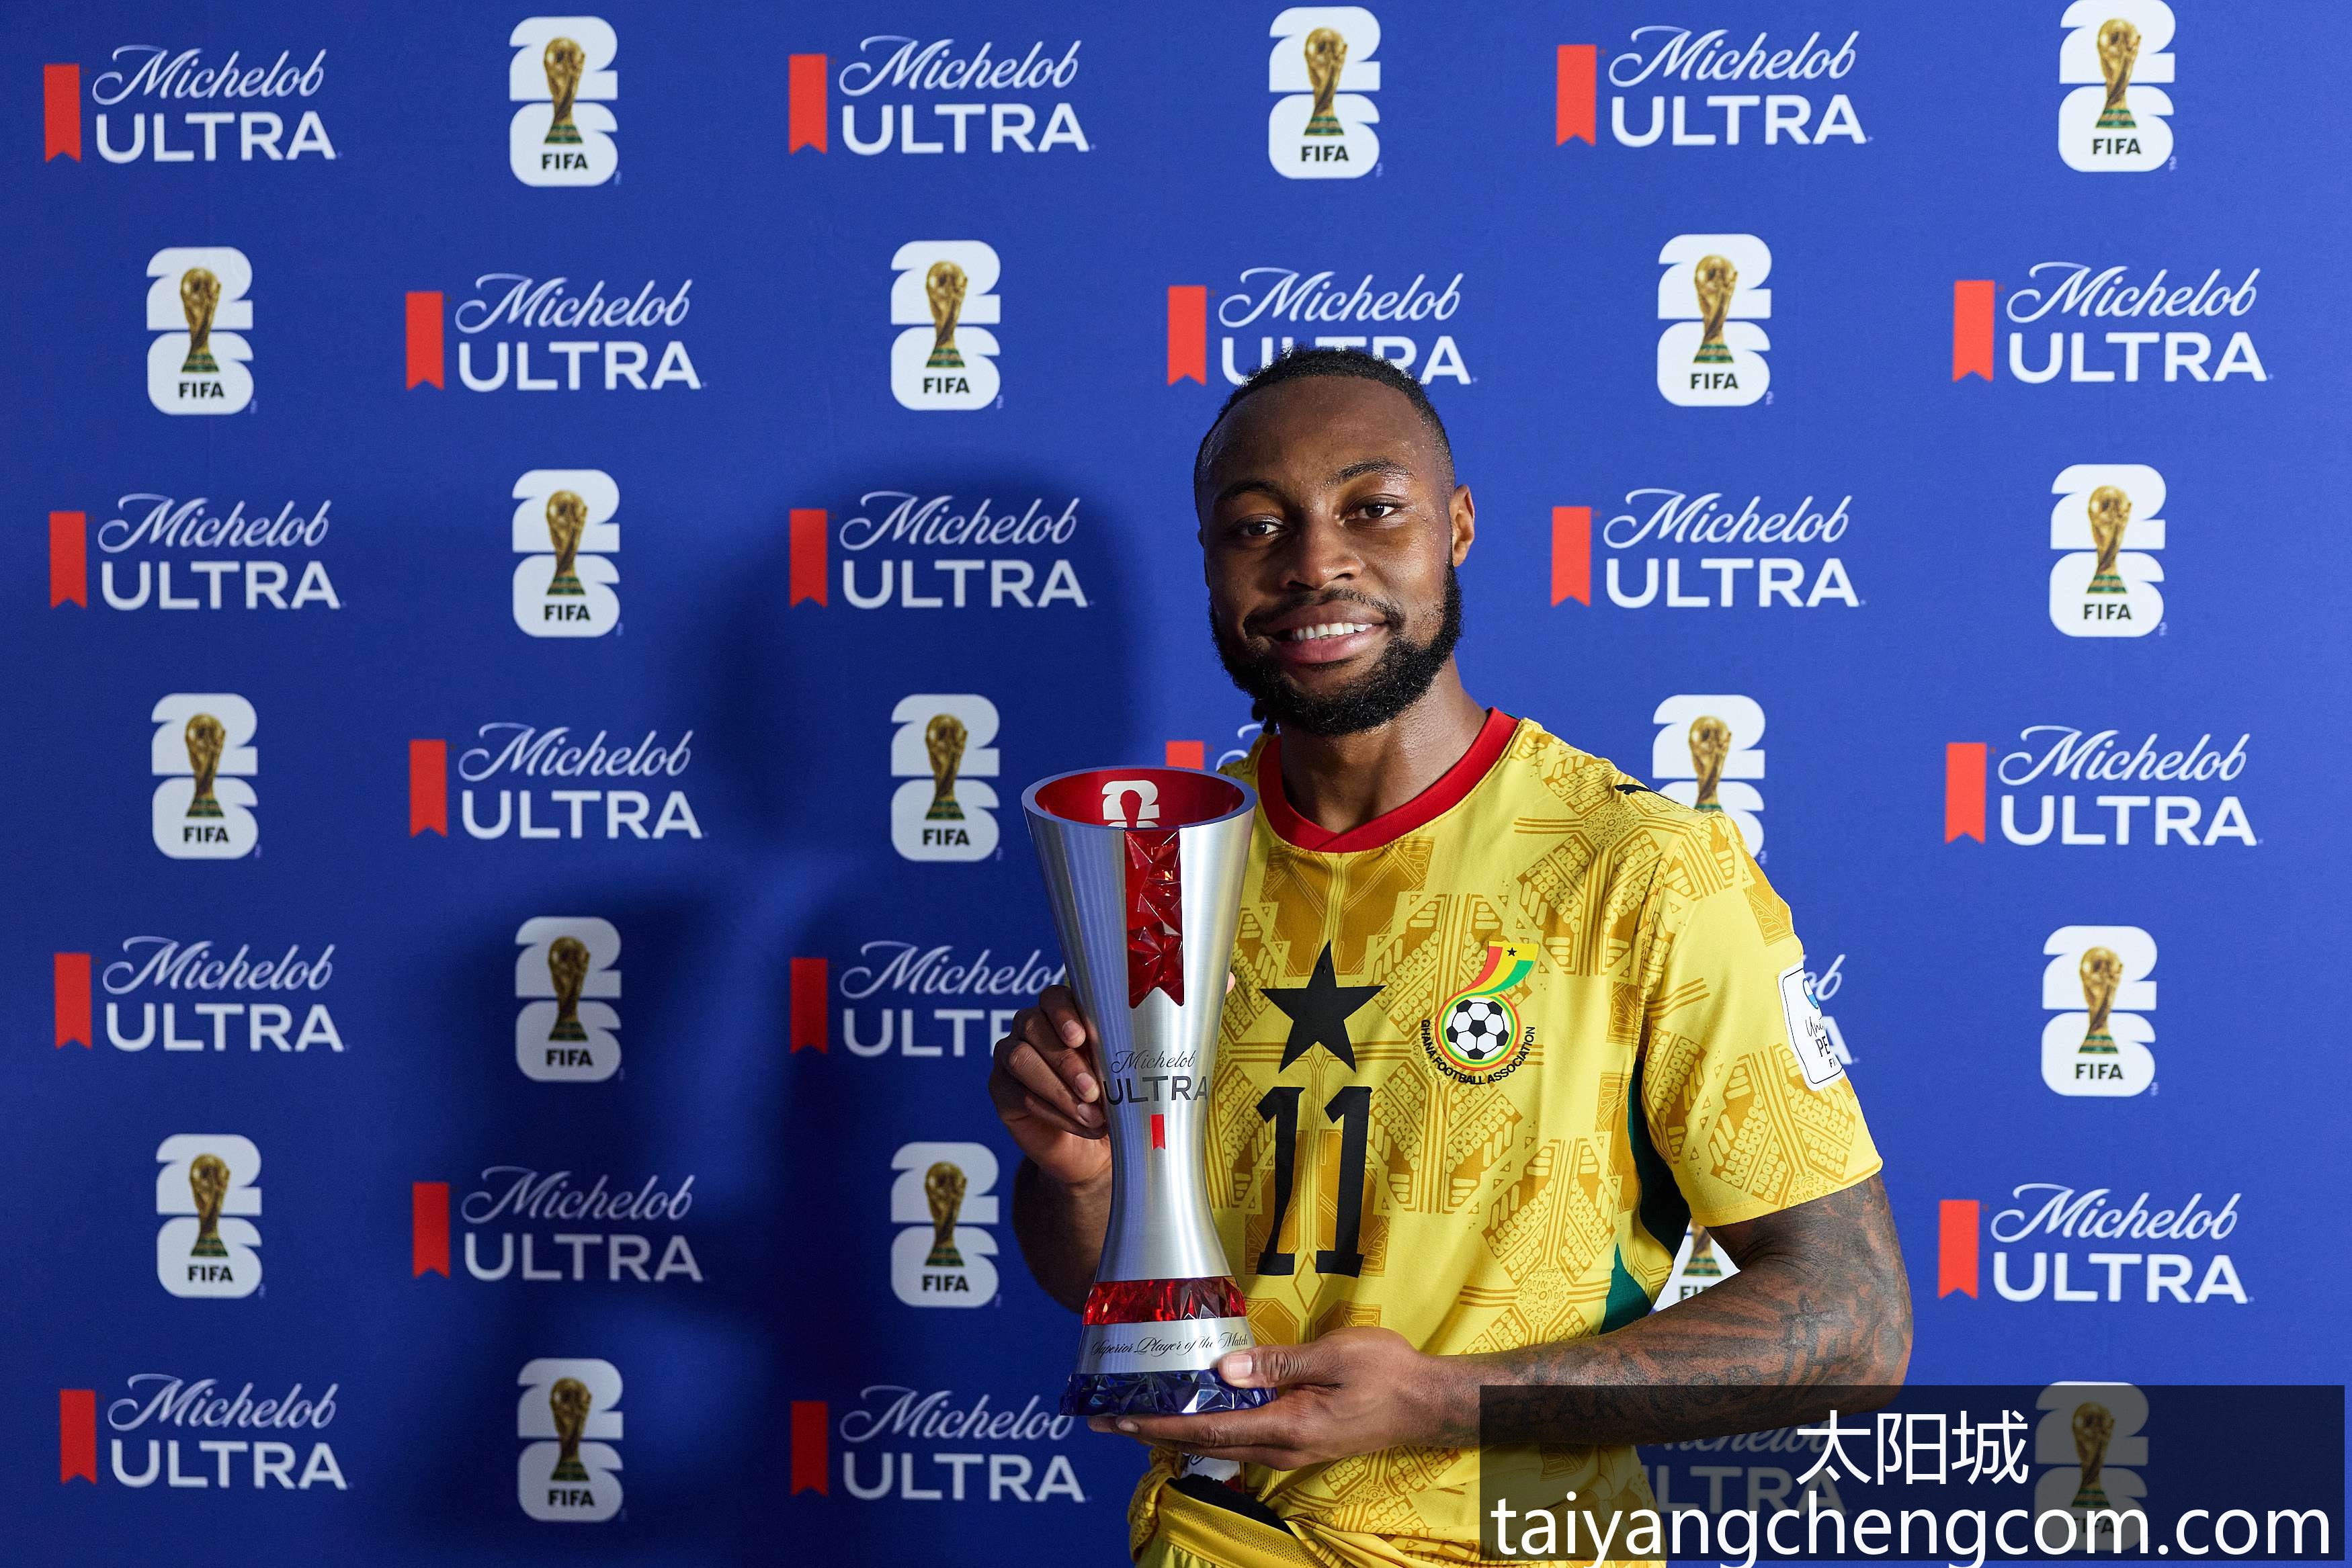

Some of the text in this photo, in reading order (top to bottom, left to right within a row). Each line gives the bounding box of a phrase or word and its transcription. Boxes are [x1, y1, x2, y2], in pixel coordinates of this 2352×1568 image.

[93, 46, 326, 105] Michelob
[839, 36, 1081, 96] Michelob
[1609, 26, 1859, 87] Michelob
[96, 111, 336, 163] ULTRA
[843, 103, 1089, 155] ULTRA
[1612, 95, 1867, 147] ULTRA
[542, 154, 588, 169] FIFA
[1302, 145, 1349, 162] FIFA
[2093, 138, 2141, 155] FIFA
[456, 274, 692, 333] Michelob
[1219, 267, 1463, 327] Michelob
[2007, 262, 2260, 322] Michelob
[459, 341, 701, 392] ULTRA
[1691, 373, 1738, 389] FIFA
[2009, 332, 2267, 384] ULTRA
[179, 382, 224, 398] FIFA
[923, 378, 970, 393] FIFA
[98, 494, 331, 552] Michelob
[839, 491, 1079, 550] Michelob
[1603, 488, 1851, 548] Michelob
[102, 561, 340, 610] ULTRA
[843, 560, 1087, 609] ULTRA
[1607, 558, 1859, 608] ULTRA
[544, 605, 590, 621] FIFA
[2084, 604, 2132, 619] FIFA
[459, 723, 692, 781] Michelob
[1999, 726, 2250, 785] Michelob
[183, 826, 228, 842] FIFA
[462, 790, 702, 839] ULTRA
[923, 829, 970, 845] FIFA
[2001, 795, 2257, 846] ULTRA
[103, 937, 335, 994] Michelob
[107, 1003, 344, 1051] ULTRA
[1421, 1019, 1536, 1084] GHANA FOOTBALL ASSOCIATION
[546, 1049, 593, 1066] FIFA
[1111, 1049, 1196, 1073] Michelob
[2076, 1063, 2123, 1080] FIFA
[1103, 1076, 1208, 1105] ULTRA
[462, 1166, 695, 1223] Michelob
[1256, 1086, 1373, 1278] 11
[1991, 1183, 2241, 1242] Michelob
[188, 1266, 233, 1282] FIFA
[465, 1234, 702, 1281] ULTRA
[1994, 1252, 2248, 1303] ULTRA
[922, 1274, 969, 1292] FIFA
[1091, 1340, 1133, 1358] Superior
[1134, 1336, 1181, 1357] Player
[1180, 1337, 1202, 1355] of
[1218, 1332, 1249, 1349] Match
[108, 1374, 338, 1431] Michelob
[112, 1439, 347, 1489] ULTRA
[845, 1452, 1085, 1502] ULTRA
[548, 1489, 595, 1506] FIFA
[1642, 1465, 1847, 1516] LTRA
